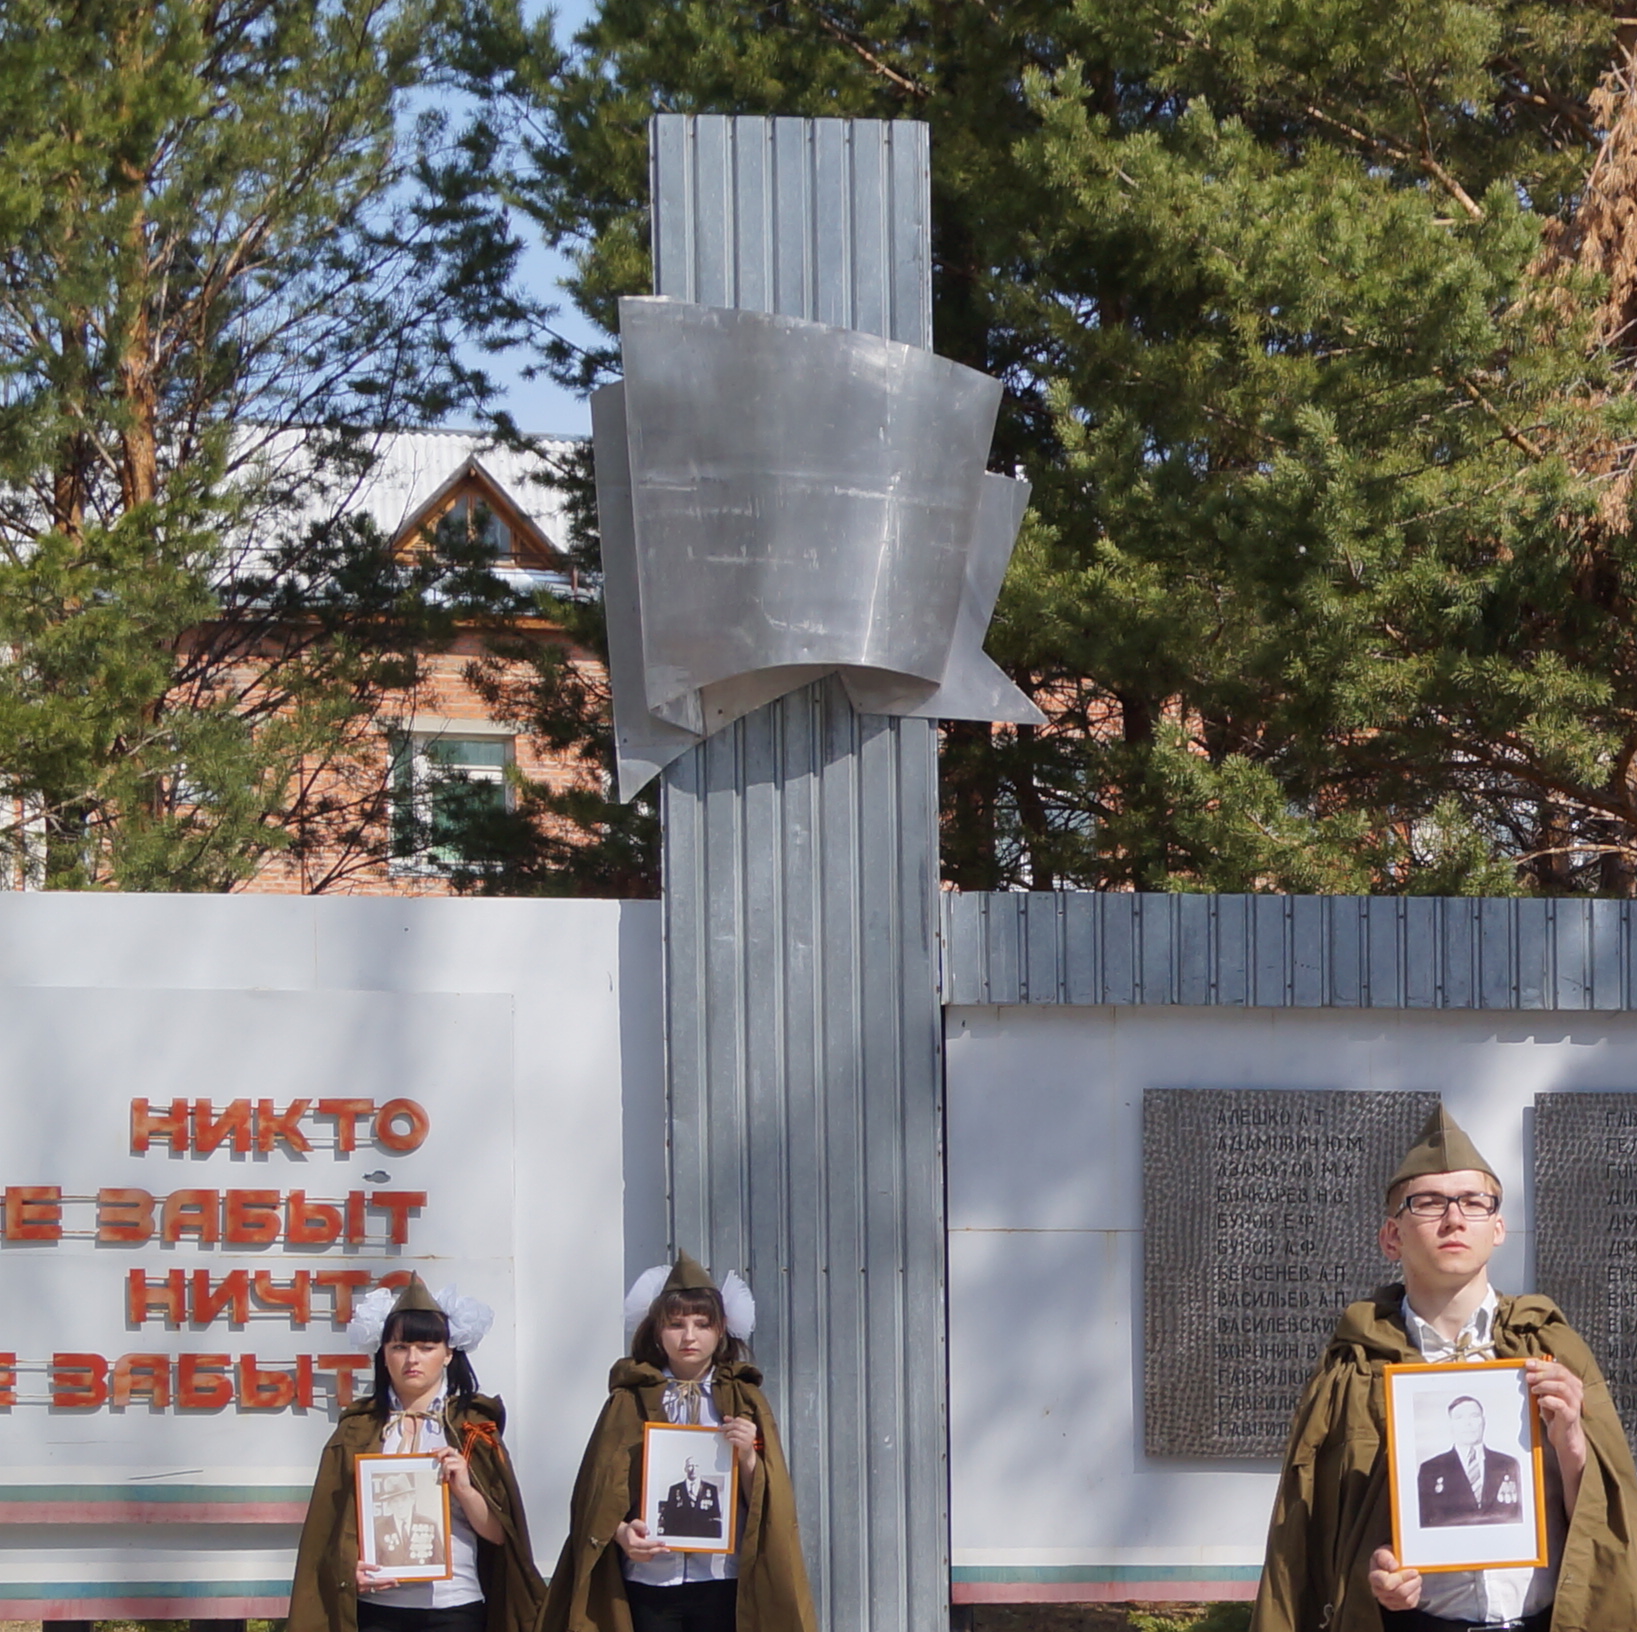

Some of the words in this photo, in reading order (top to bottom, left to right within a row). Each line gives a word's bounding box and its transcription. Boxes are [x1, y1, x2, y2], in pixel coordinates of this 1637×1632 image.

[1217, 1109, 1291, 1125] АЛЕШКО
[131, 1098, 430, 1153] НИКТО
[1216, 1136, 1319, 1151] АДАМОВИЧ
[1216, 1162, 1314, 1177] АЗАМАТОВ
[1216, 1188, 1309, 1203] БОЧКАРЕВ
[4, 1186, 62, 1240] Е
[96, 1188, 428, 1245] ЗАБЫТ
[1217, 1214, 1274, 1229] БУРОВ
[1217, 1240, 1274, 1255] БУРОВ
[1216, 1266, 1310, 1281] БЕРСЕНЕВ
[1218, 1292, 1310, 1307] ВАСИЛЬЕВ
[1218, 1343, 1298, 1359] ВОРОНИН
[52, 1353, 373, 1408] ЗАБЫТ
[1218, 1395, 1301, 1411] ГАВРИЛЮ
[1218, 1421, 1292, 1436] ГАВРИЛ
